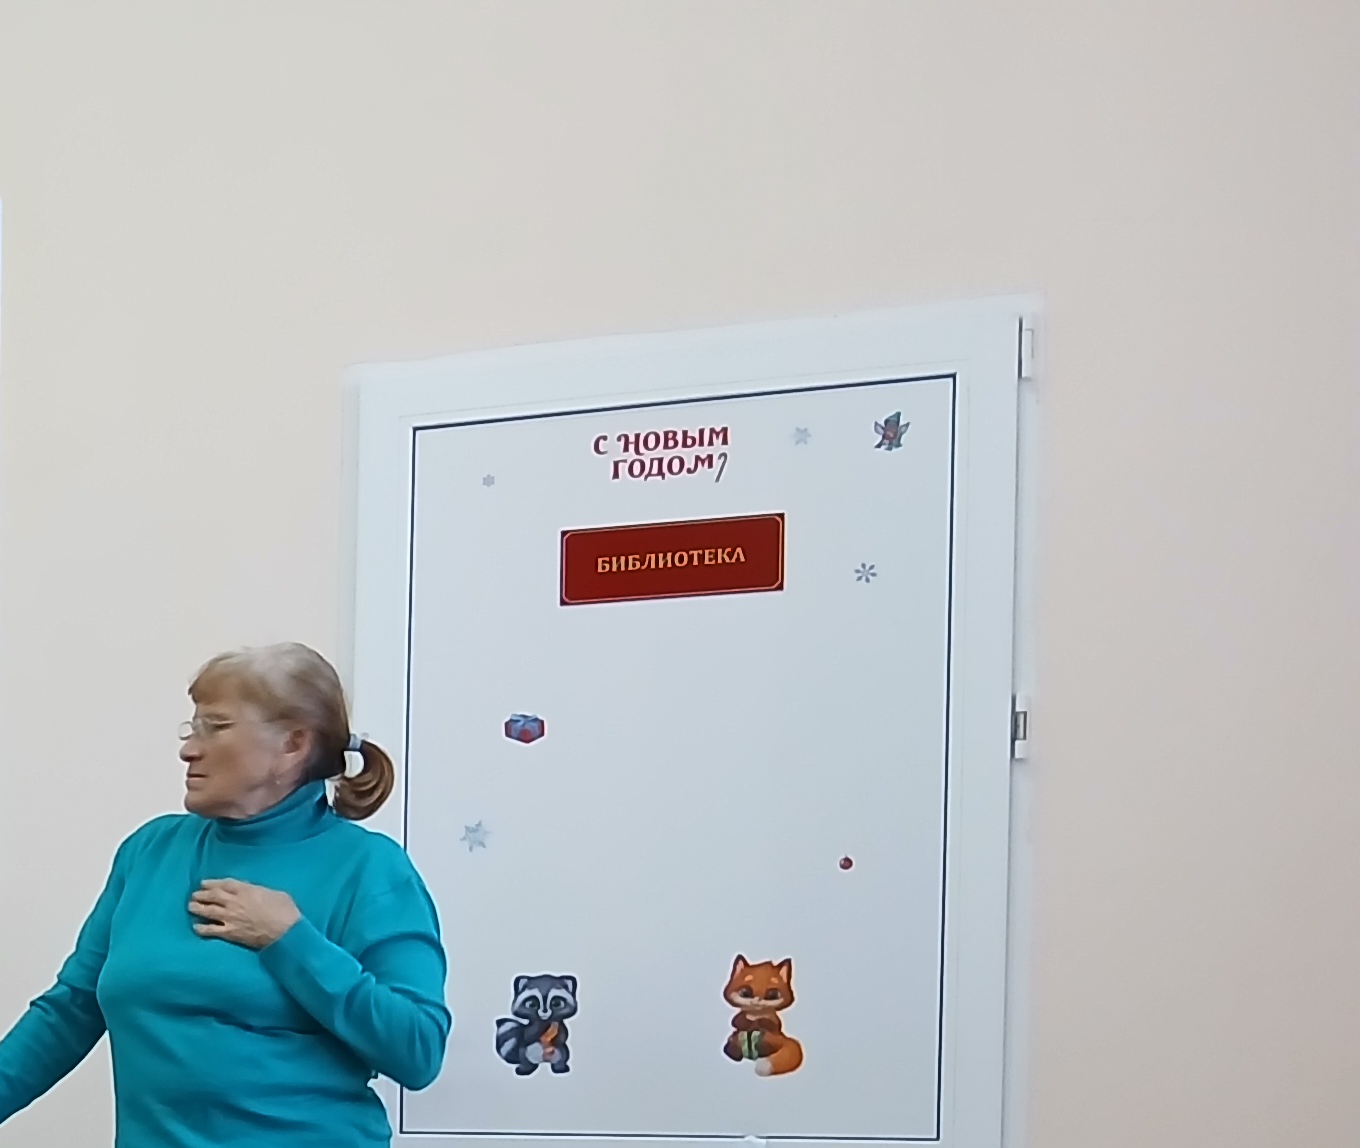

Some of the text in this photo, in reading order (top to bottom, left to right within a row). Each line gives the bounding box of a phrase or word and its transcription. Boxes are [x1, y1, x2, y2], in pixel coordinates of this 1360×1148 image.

[593, 426, 729, 456] С НОВЫМ
[597, 547, 746, 573] БИБЛИОТЕКА
